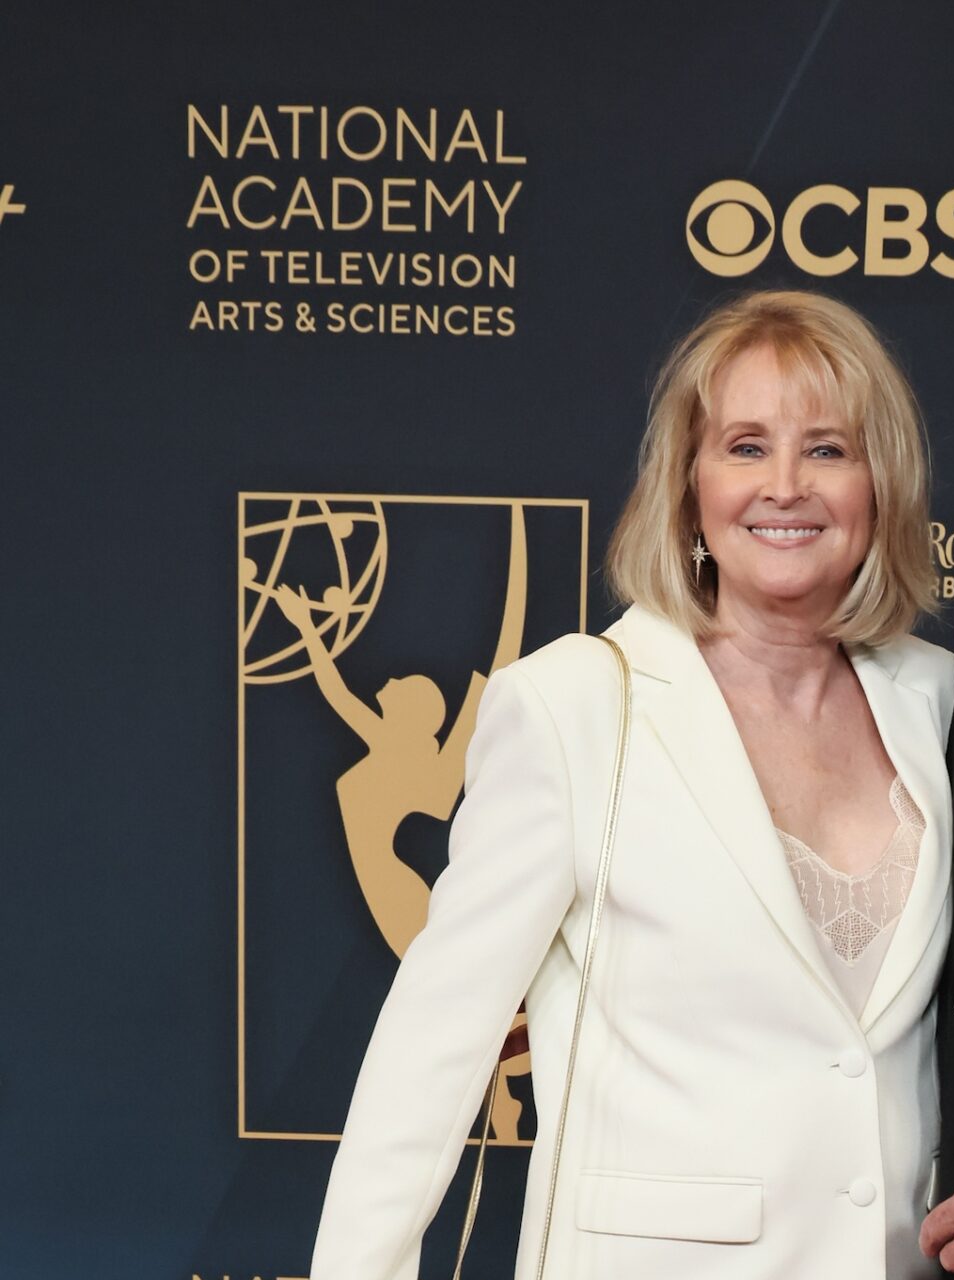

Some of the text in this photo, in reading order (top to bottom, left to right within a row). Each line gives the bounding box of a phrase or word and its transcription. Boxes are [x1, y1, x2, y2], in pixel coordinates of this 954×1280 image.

[186, 103, 528, 165] NATIONAL
[186, 174, 523, 235] ACADEMY
[188, 248, 517, 289] OF TELEVISION
[189, 300, 516, 337] ARTS & SCIENCES
